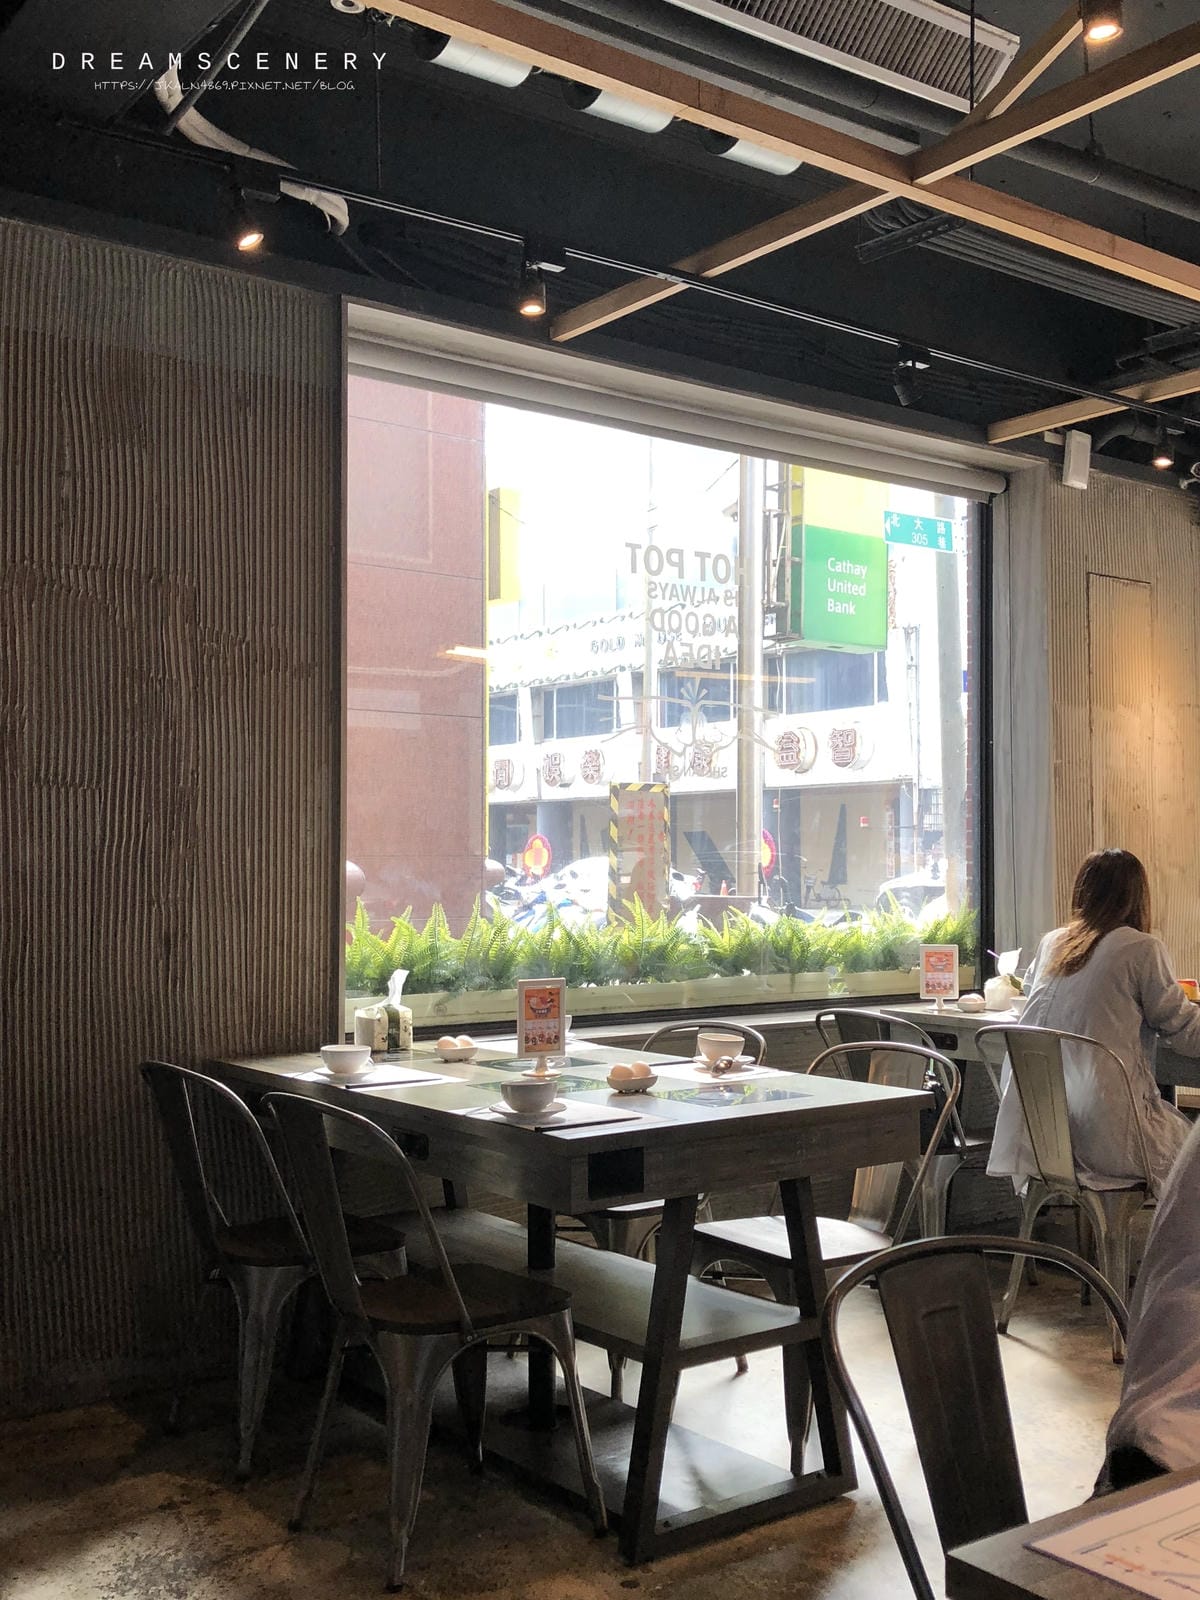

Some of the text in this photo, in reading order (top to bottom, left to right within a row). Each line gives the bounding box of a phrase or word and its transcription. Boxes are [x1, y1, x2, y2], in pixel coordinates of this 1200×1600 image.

[827, 557, 868, 578] Cathay
[827, 578, 867, 596] United
[827, 598, 856, 615] Bank
